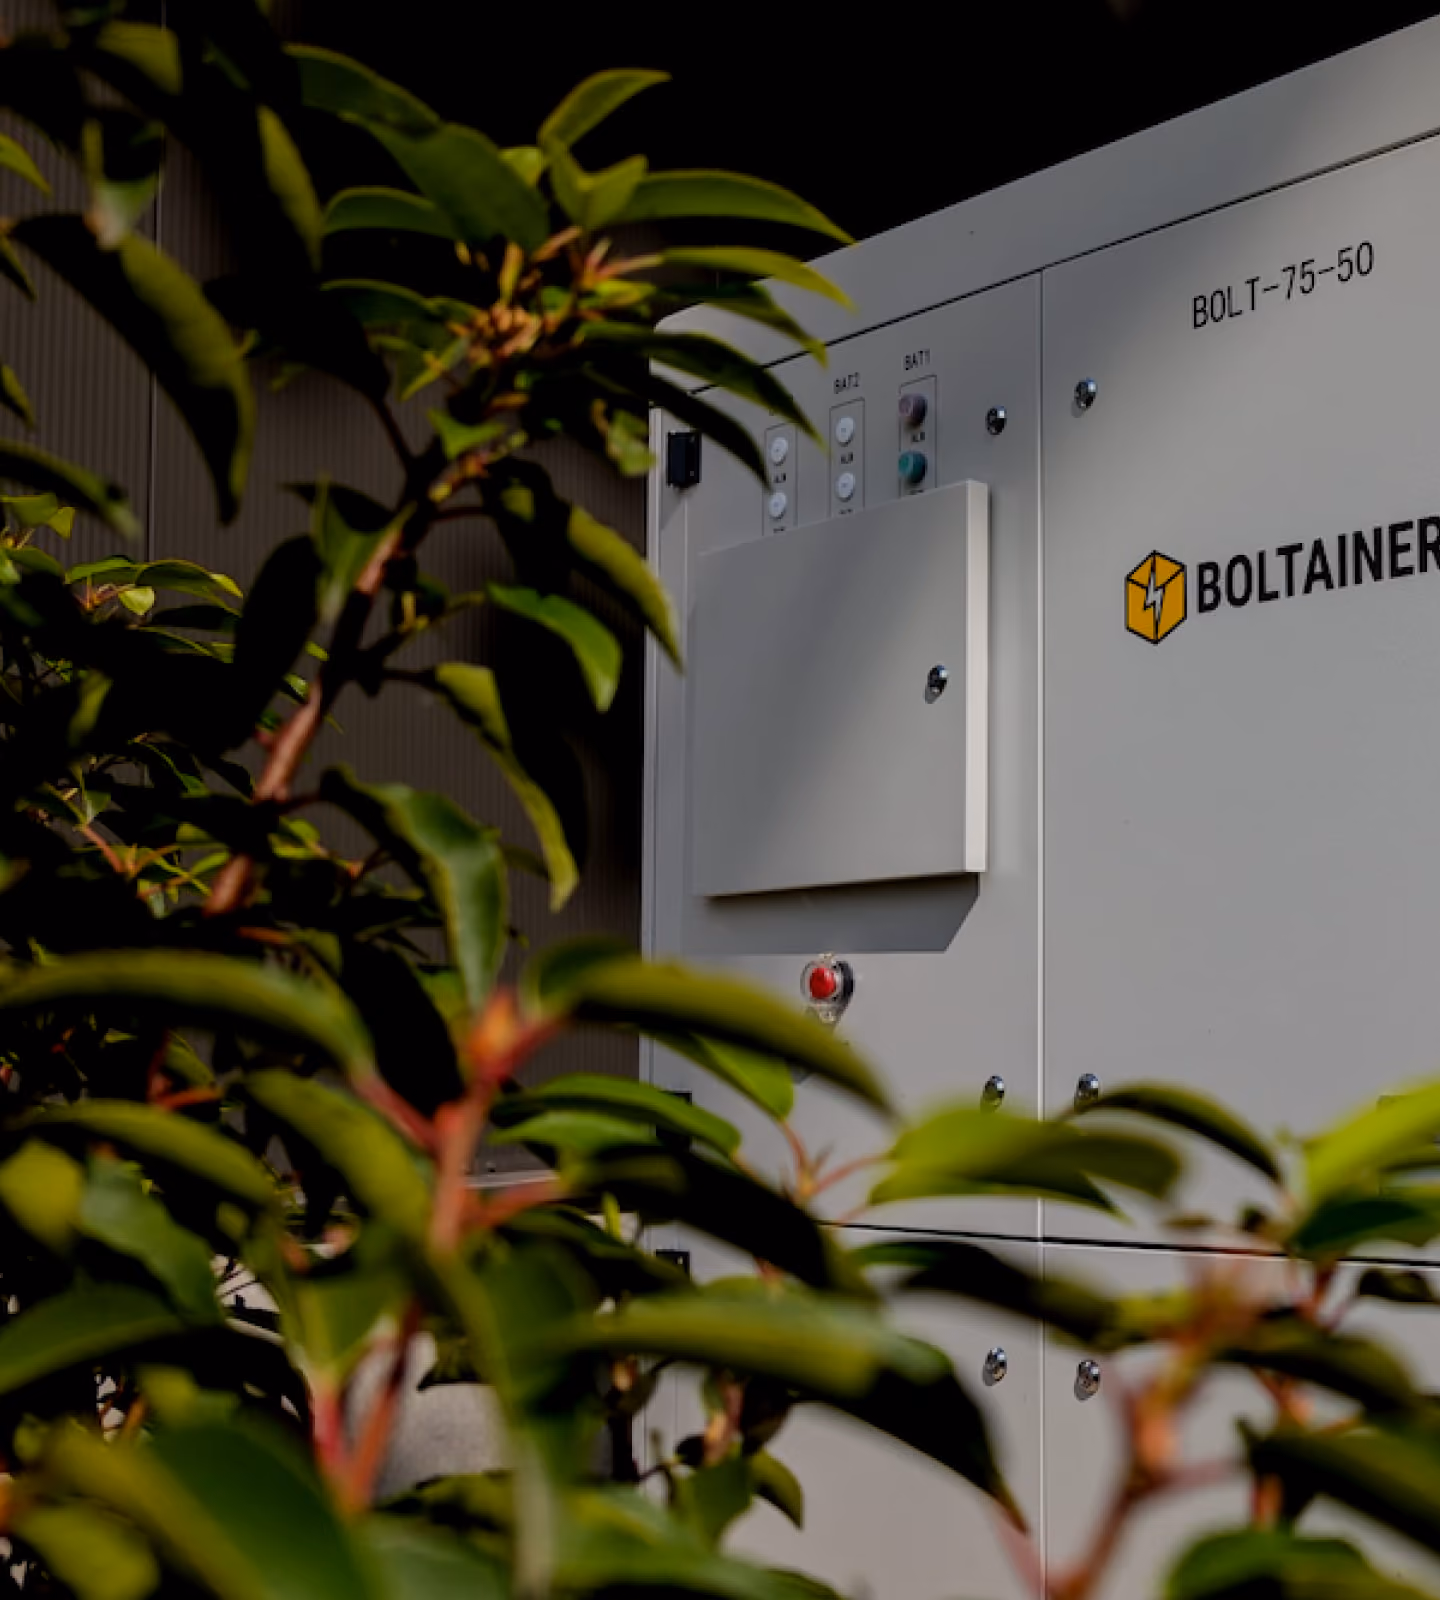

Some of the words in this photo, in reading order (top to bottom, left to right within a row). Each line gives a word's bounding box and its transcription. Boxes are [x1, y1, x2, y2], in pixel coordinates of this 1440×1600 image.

[1192, 240, 1375, 330] BOLT-75-50
[903, 348, 931, 371] BAT1
[833, 371, 861, 394] BAT2
